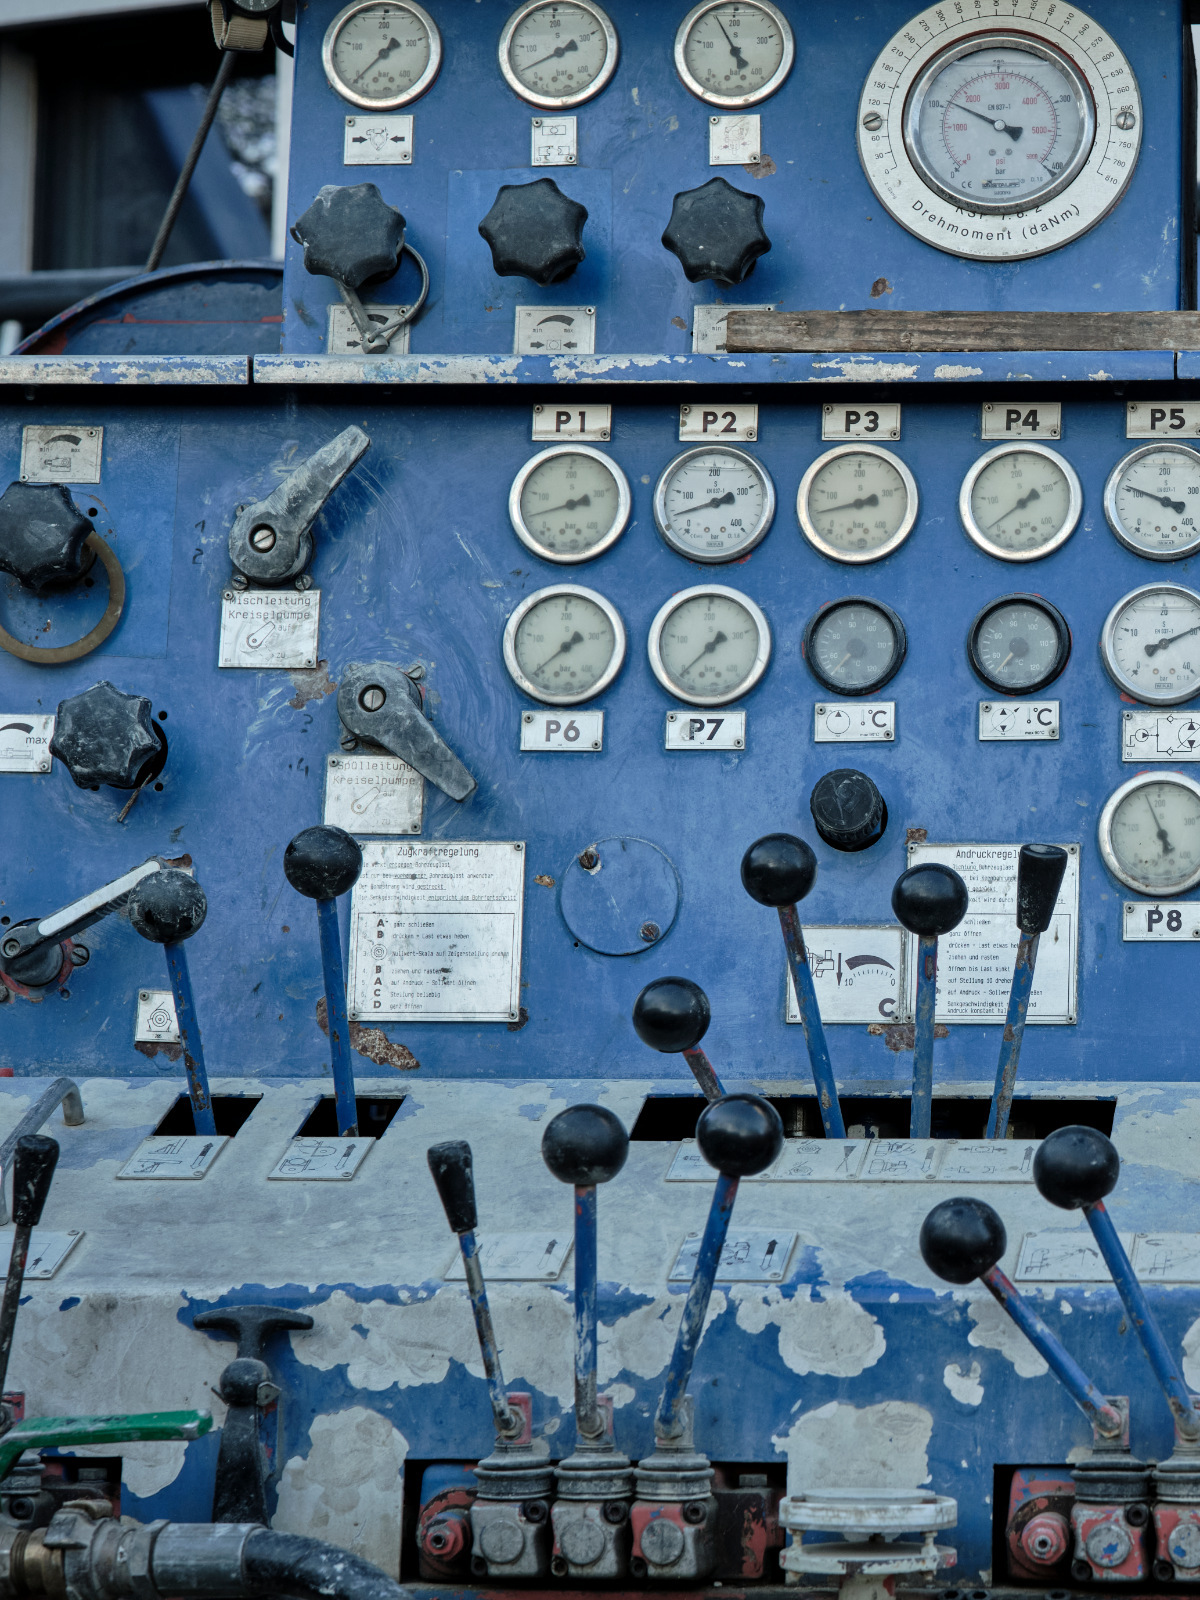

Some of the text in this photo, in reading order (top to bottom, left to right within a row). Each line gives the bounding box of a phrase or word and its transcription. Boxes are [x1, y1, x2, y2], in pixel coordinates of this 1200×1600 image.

[954, 1, 963, 14] 330
[1047, 4, 1057, 17] 480
[935, 9, 946, 22] 300
[1064, 12, 1075, 25] 510
[549, 20, 561, 28] 200
[729, 19, 740, 27] 200
[918, 19, 930, 32] 270
[1078, 23, 1090, 36] 540
[579, 34, 590, 42] 300
[756, 37, 768, 45] 300
[903, 32, 916, 44] 240
[1091, 36, 1104, 48] 570
[352, 43, 362, 51] 100
[405, 39, 417, 47] 300
[702, 41, 714, 49] 100
[526, 45, 537, 53] 100
[891, 46, 904, 57] 210
[1102, 51, 1115, 62] 600
[882, 62, 894, 73] 180
[1110, 68, 1124, 78] 630
[873, 81, 886, 90] 150
[994, 82, 1010, 90] 3000
[1116, 85, 1130, 94] 660
[868, 98, 881, 106] 120
[965, 95, 981, 103] 2000
[1022, 97, 1038, 105] 4000
[1059, 95, 1071, 103] 300
[929, 100, 940, 108] 100
[1118, 140, 1132, 149] 750
[874, 152, 884, 160] 30
[995, 158, 1006, 166] psi
[1051, 162, 1064, 170] 400
[1113, 159, 1126, 168] 780
[1104, 174, 1118, 185] 810
[912, 200, 1081, 241] Drehmoment (daNm)
[555, 411, 587, 433] P1
[702, 411, 737, 433] P2
[845, 410, 880, 433] P3
[1005, 409, 1040, 431] P4
[1150, 408, 1186, 430] P5
[565, 470, 577, 479] 200
[708, 468, 721, 477] 200
[853, 469, 866, 478] 200
[682, 491, 694, 500] 100
[736, 487, 749, 495] 300
[730, 518, 743, 527] 400
[229, 596, 311, 606] Mischleitung
[228, 610, 310, 621] Kreiselpumpe
[278, 624, 291, 632] auf
[1130, 629, 1138, 637] 10
[1182, 661, 1191, 670] 40
[868, 709, 887, 728] °C
[1033, 707, 1053, 726] °C
[545, 719, 580, 743] P6
[689, 718, 725, 741] P7
[25, 736, 47, 744] max
[337, 761, 413, 772] Spülleitung
[333, 776, 416, 786] Kreiselpumpe
[397, 847, 479, 858] Zugkraftregelung
[376, 919, 385, 928] A
[1147, 909, 1182, 932] P8
[373, 989, 381, 997] C
[878, 998, 896, 1017] C
